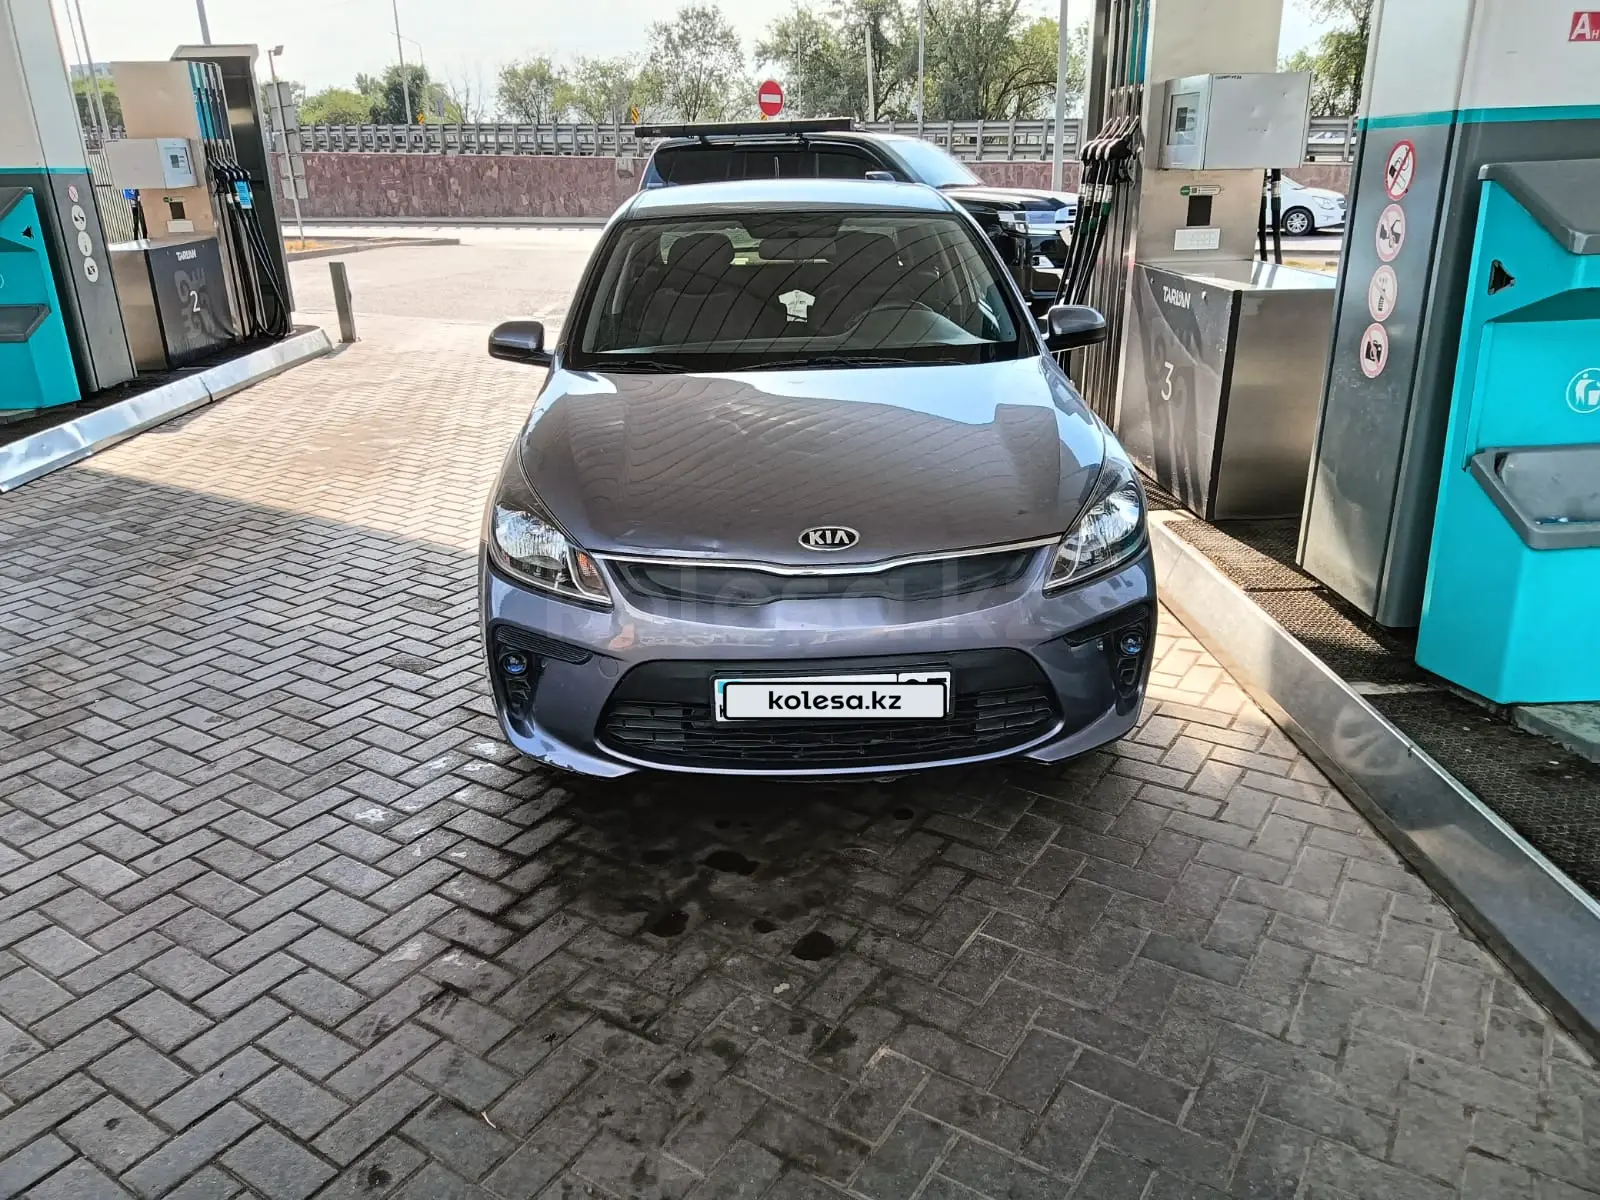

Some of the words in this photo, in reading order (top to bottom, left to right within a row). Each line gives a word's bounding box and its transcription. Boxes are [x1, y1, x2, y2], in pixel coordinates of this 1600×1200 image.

[190, 290, 200, 313] 2
[1163, 285, 1191, 310] TARLAN
[1161, 361, 1174, 400] 3
[809, 530, 850, 545] KIA
